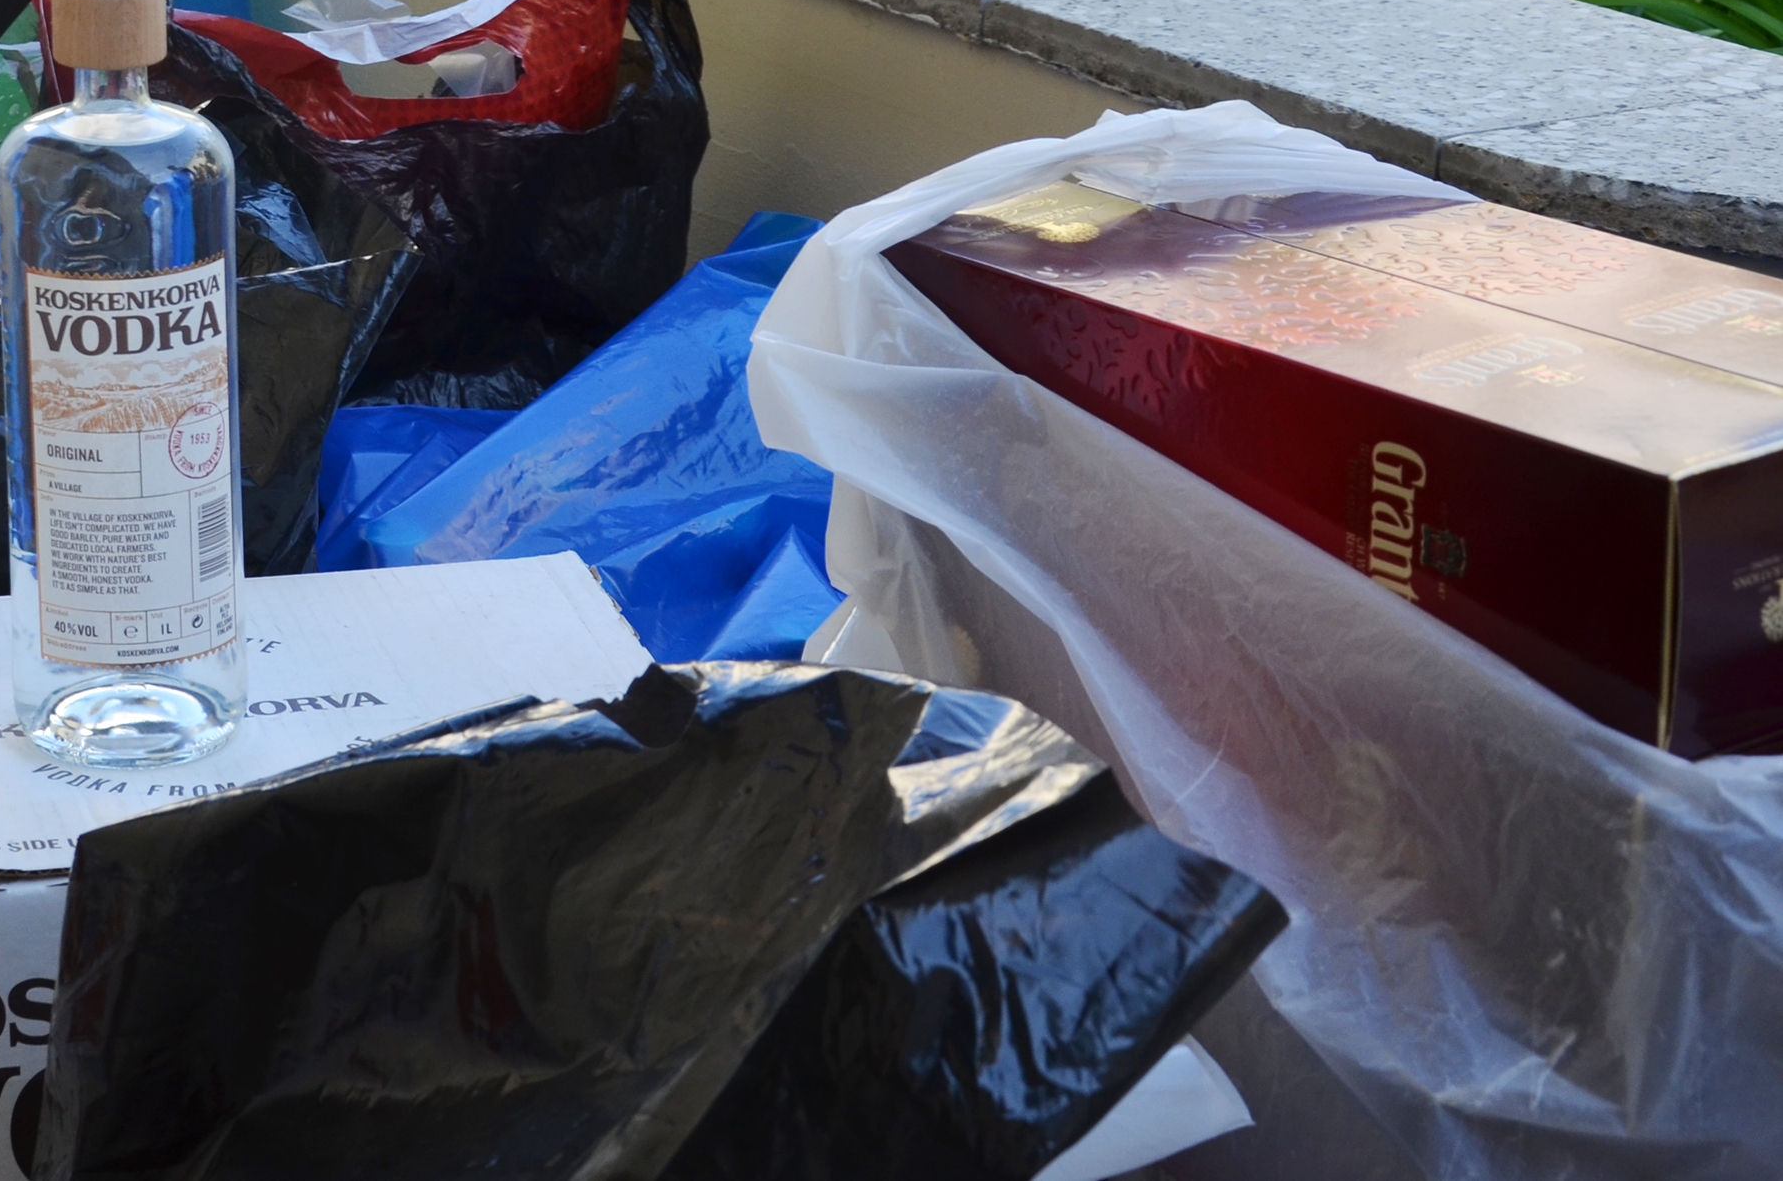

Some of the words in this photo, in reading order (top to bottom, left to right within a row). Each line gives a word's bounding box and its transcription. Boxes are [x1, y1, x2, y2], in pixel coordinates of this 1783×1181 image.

[35, 273, 220, 312] KOSKENKORVA
[36, 300, 222, 356] VODKA
[190, 432, 211, 445] 1953
[46, 443, 103, 463] ORIGINAL
[54, 481, 83, 494] VILLAGE
[49, 508, 56, 517] IN
[58, 510, 71, 519] THE
[72, 512, 103, 522] VILLAGE
[105, 514, 115, 522] OF
[1371, 440, 1427, 602] Grant
[50, 519, 63, 529] LIFE
[65, 521, 83, 531] ISN'T
[85, 523, 141, 533] COMPLICATED.
[143, 522, 157, 531] WE
[158, 519, 177, 529] HAVE
[50, 528, 69, 539] GOOD
[70, 531, 101, 543] BARLEY,
[102, 534, 123, 543] PURE
[125, 534, 152, 543] WATER
[153, 531, 170, 540] AND
[51, 539, 89, 552] DEDICATED
[91, 544, 115, 554] LOCAL
[117, 543, 156, 554] FARMERS.
[51, 549, 62, 559] WE
[63, 552, 84, 562] WORK
[86, 555, 106, 563] WITH
[107, 554, 146, 564] NATURE'S
[147, 552, 167, 562] BEST
[51, 560, 98, 573] INGREDIENTS
[100, 565, 110, 574] TO
[112, 565, 142, 574] CREATE
[91, 576, 123, 584] HONEST
[124, 575, 153, 584] VODKA.
[52, 580, 65, 590] IT'S
[66, 583, 75, 591] AS
[77, 584, 105, 594] SIMPLE
[106, 586, 116, 594] AS
[118, 586, 140, 595] THAT.
[78, 623, 99, 638] VOL
[117, 645, 179, 657] KOSKENKORVA.COM
[32, 763, 127, 794] VODKA
[7, 838, 63, 853] SIDE
